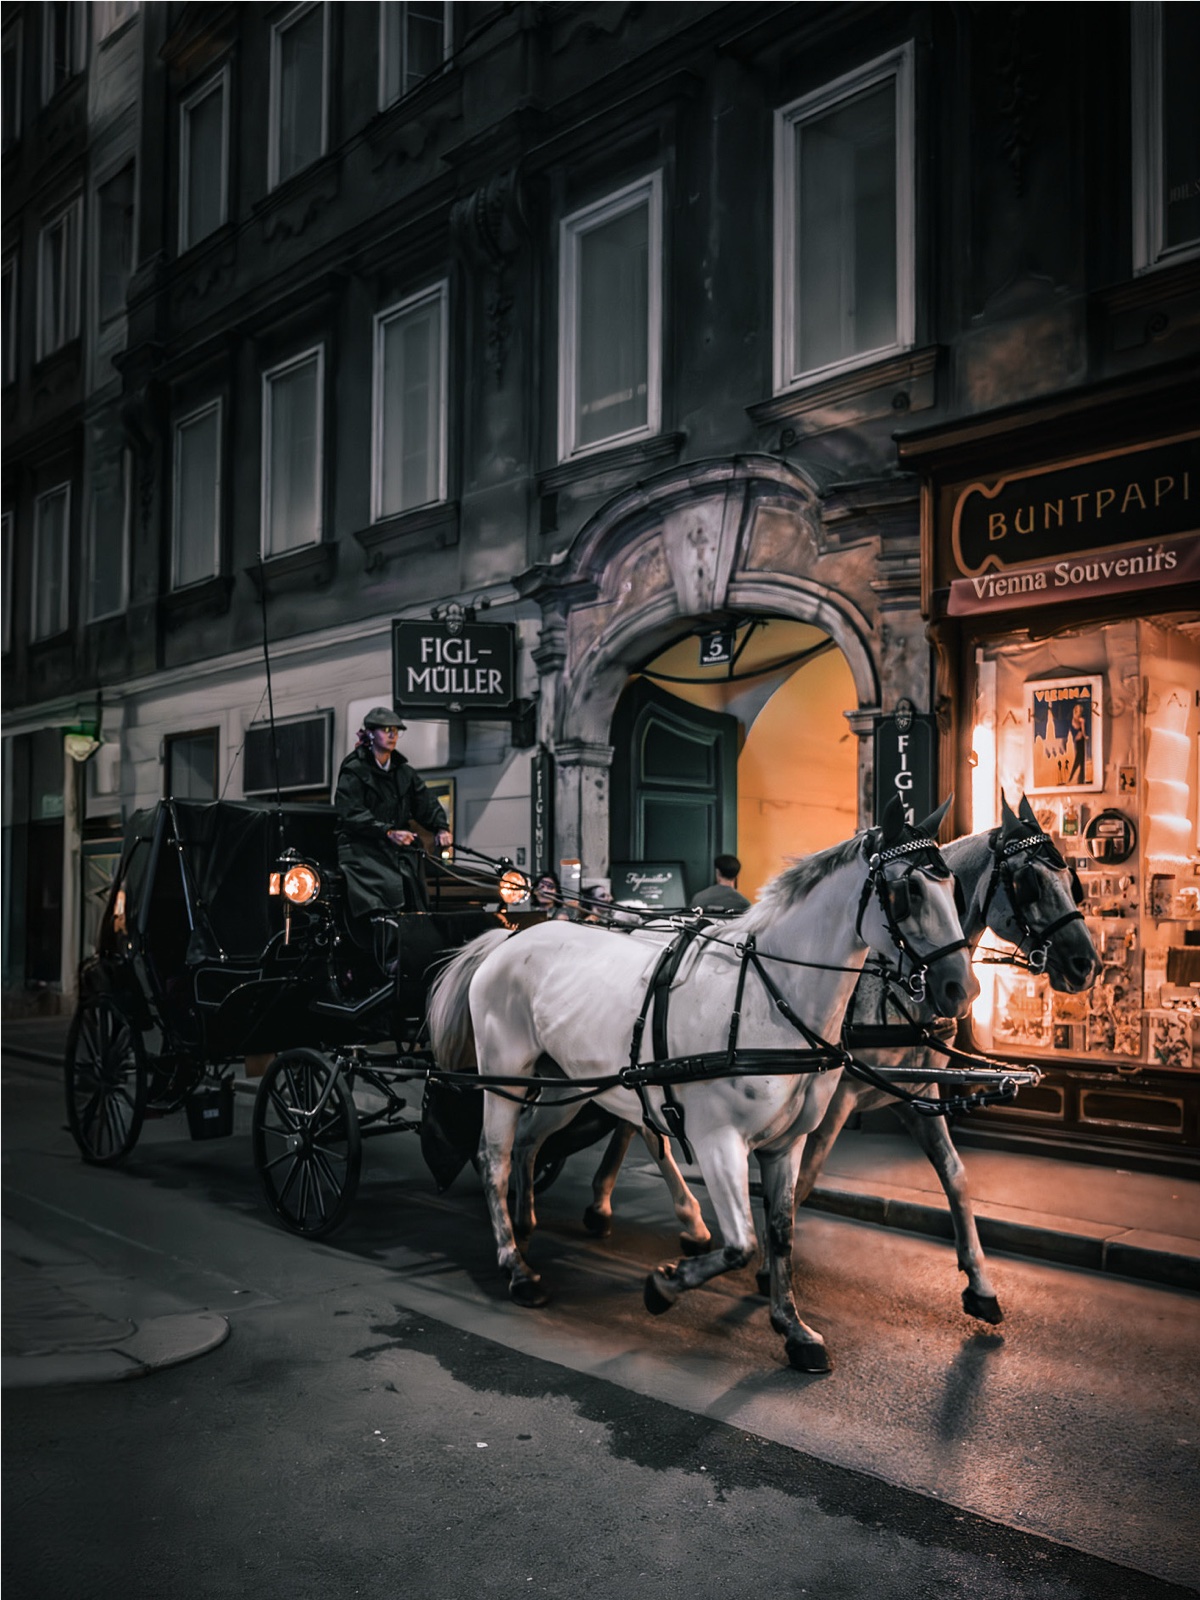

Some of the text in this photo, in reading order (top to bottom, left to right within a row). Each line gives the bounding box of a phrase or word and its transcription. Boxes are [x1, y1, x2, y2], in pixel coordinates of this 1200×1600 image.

[988, 472, 1190, 541] BUNTPAPI
[971, 547, 1177, 599] Vienna Souvenirs
[420, 637, 492, 664] FIGL-
[709, 636, 723, 657] 5
[407, 665, 504, 694] MÜLLER
[1035, 686, 1091, 703] VIENNA
